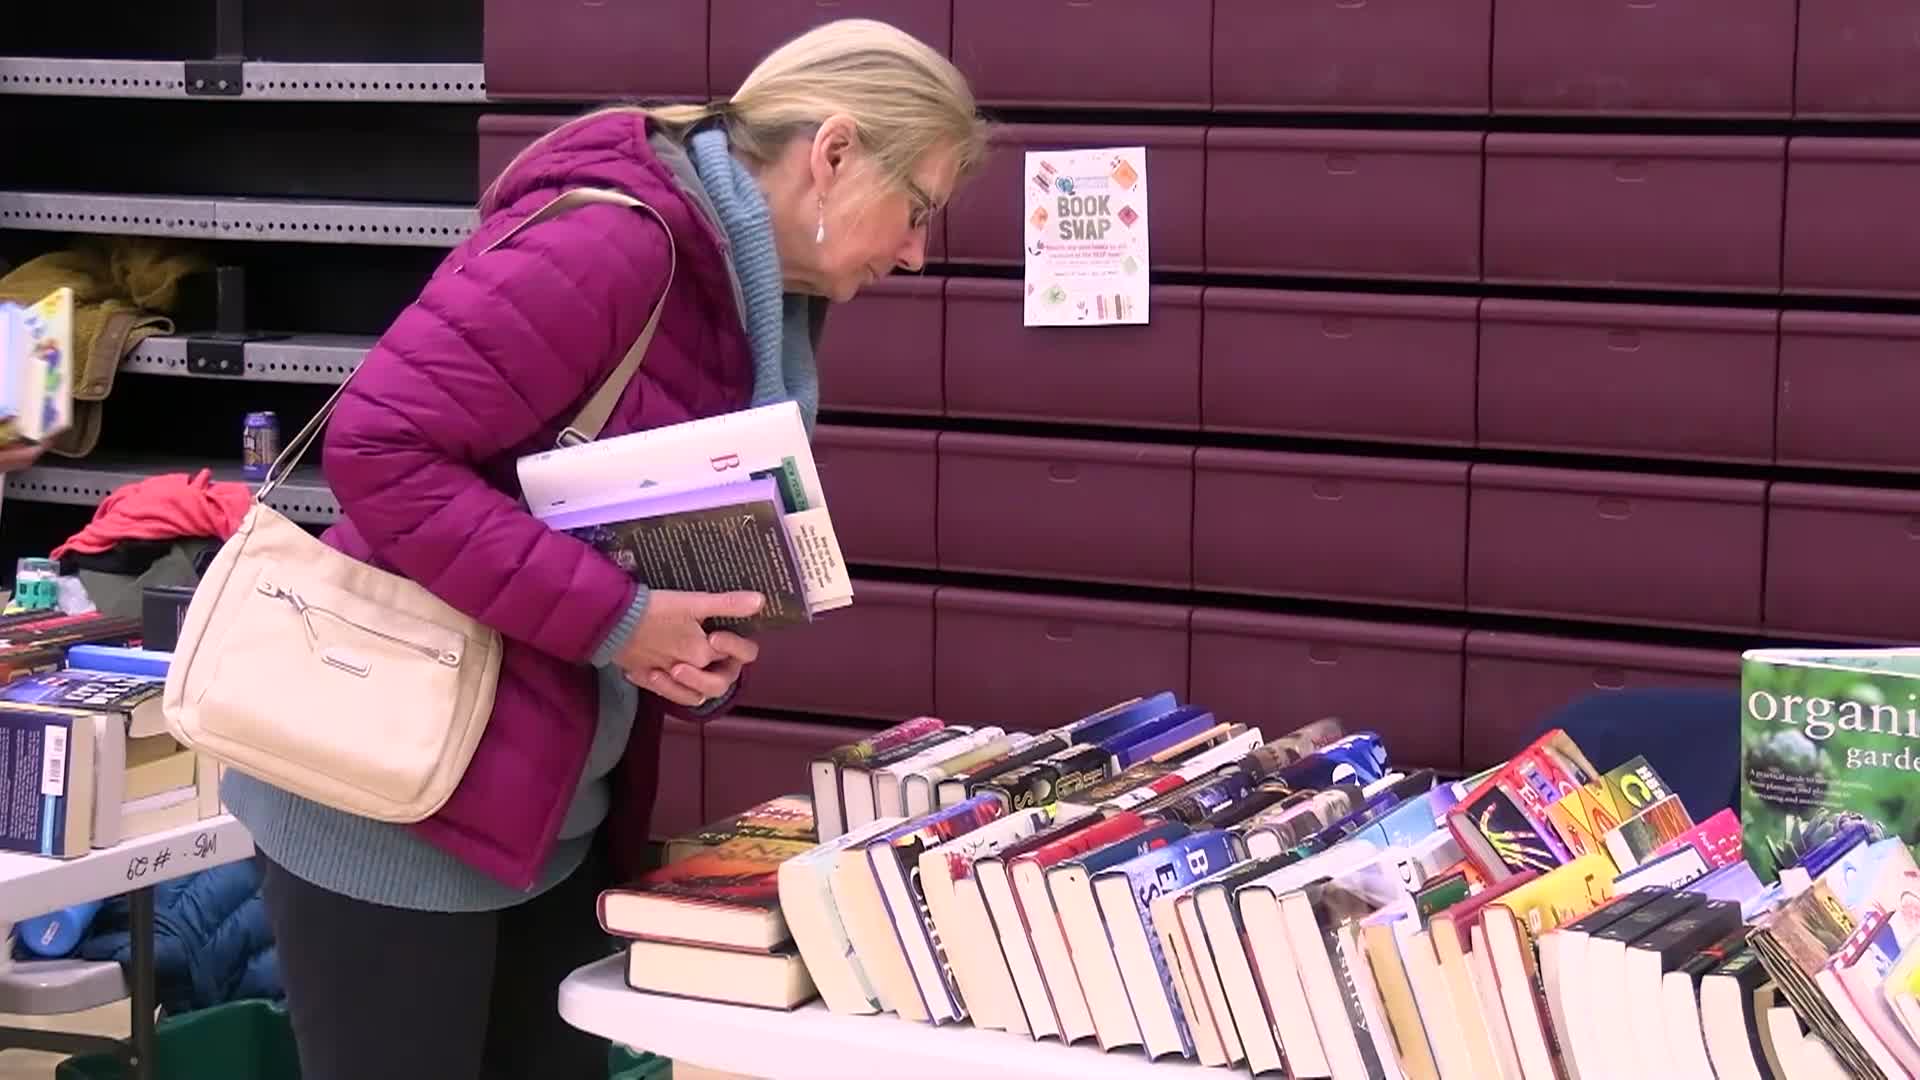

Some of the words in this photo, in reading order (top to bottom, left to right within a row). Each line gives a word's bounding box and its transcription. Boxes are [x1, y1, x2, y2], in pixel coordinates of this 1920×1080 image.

[1057, 195, 1112, 218] BOOK
[1058, 219, 1112, 240] SWAP
[1748, 691, 1920, 739] organi
[1847, 746, 1920, 771] garde
